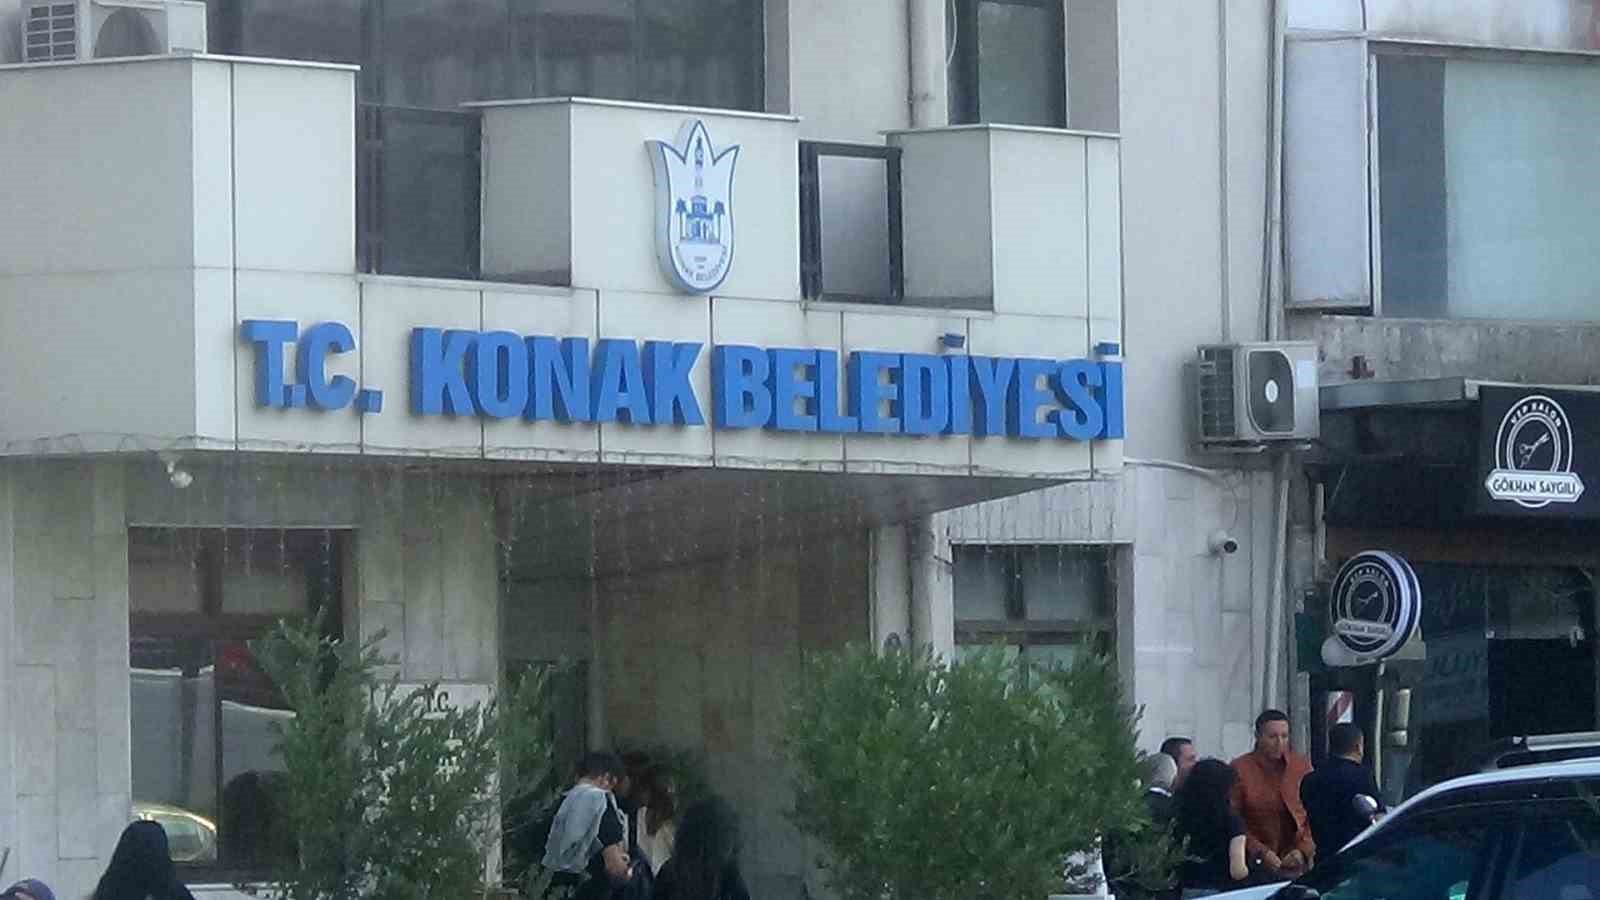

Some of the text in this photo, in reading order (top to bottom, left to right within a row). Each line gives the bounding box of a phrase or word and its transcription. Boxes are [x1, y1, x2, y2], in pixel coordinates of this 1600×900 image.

[241, 319, 1125, 440] T.C. KONAK BELEDİYESİ
[1493, 477, 1576, 495] GÖKHAN SAYGILI
